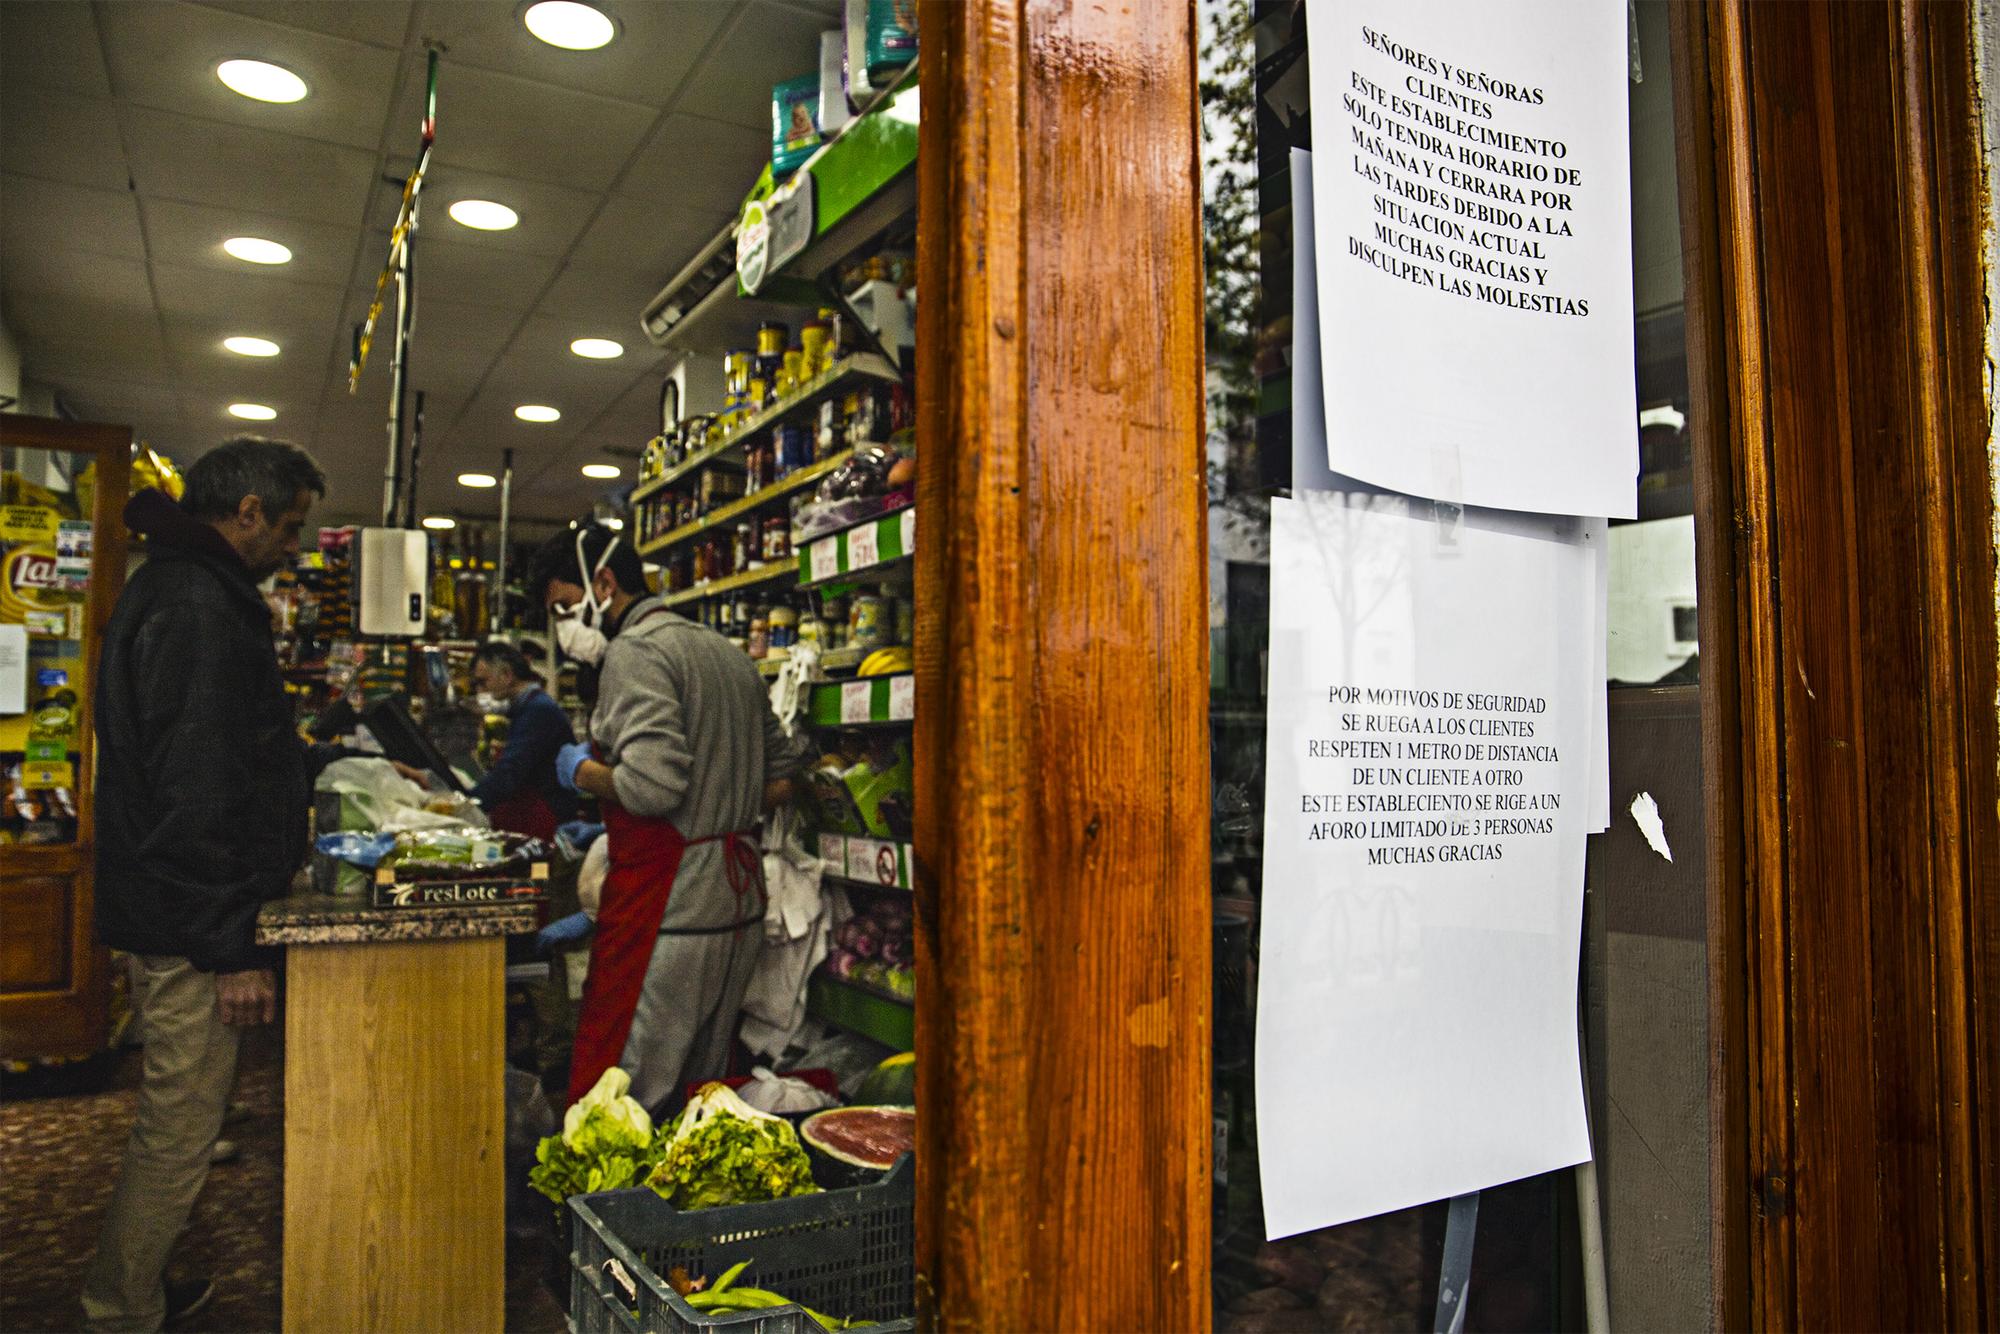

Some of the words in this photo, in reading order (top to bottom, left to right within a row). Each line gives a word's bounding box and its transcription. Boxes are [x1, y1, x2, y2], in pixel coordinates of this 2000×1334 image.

[1362, 25, 1437, 76] SEÑORES
[1441, 62, 1453, 80] Y
[1457, 68, 1544, 105] SEÑORAS
[1351, 70, 1387, 108] ESTE
[1391, 94, 1567, 159] ESTABLECIMIENTO
[1406, 75, 1493, 120] CLIENTES
[1343, 92, 1382, 130] SOLO
[1386, 118, 1454, 160] TENDRA
[1459, 146, 1548, 182] HORARIO
[1554, 167, 1582, 186] DE
[1351, 125, 1419, 174] MAÑANA
[1423, 159, 1435, 178] Y
[1438, 166, 1526, 204] CERRARA
[1531, 189, 1573, 211] POR
[1355, 155, 1381, 184] LAS
[1385, 170, 1449, 210] TARDES
[1454, 198, 1522, 230] DEBIDO
[1527, 216, 1540, 233] A
[1545, 218, 1573, 236] LA
[1374, 194, 1464, 241] SITUACION
[1469, 230, 1546, 260] ACTUAL
[1374, 221, 1444, 263] MUCHAS
[1449, 249, 1530, 284] GRACIAS
[1534, 268, 1548, 286] Y
[1349, 235, 1434, 287] DISCULPEN
[1440, 273, 1472, 297] LAS
[1476, 283, 1589, 317] MOLESTIAS
[1329, 686, 1360, 704] POR
[1367, 688, 1439, 708] MOTIVOS
[1444, 692, 1463, 709] DE
[1467, 693, 1546, 714] SEGURIDAD
[1342, 714, 1360, 731] SE
[1366, 714, 1420, 733] RUEGA
[1423, 718, 1434, 733] A
[1438, 718, 1466, 735] LOS
[1469, 719, 1534, 737] CLIENTES
[1309, 740, 1392, 758] RESPETEN
[1397, 742, 1402, 759] 1
[1408, 742, 1461, 760] METRO
[1465, 744, 1484, 760] DE
[1488, 745, 1559, 762] DISTANCIA
[1352, 768, 1374, 785] DE
[1380, 768, 1402, 785] UN
[1406, 768, 1470, 786] CLIENTE
[1472, 770, 1482, 786] A
[1485, 770, 1523, 786] OTRO
[1302, 795, 1342, 812] ESTE
[1346, 795, 1472, 812] ESTABLECIENTO
[1475, 794, 1492, 810] SE
[1495, 794, 1527, 810] RIGE
[1529, 794, 1538, 810] A
[1541, 794, 1560, 810] UN
[1309, 822, 1366, 840] AFORO
[1371, 820, 1447, 838] LIMITADO
[1450, 820, 1470, 836] DE
[1474, 820, 1480, 836] 3
[1484, 818, 1553, 835] PERSONAS
[1368, 846, 1434, 865] MUCHAS
[1438, 844, 1502, 862] GRACIAS
